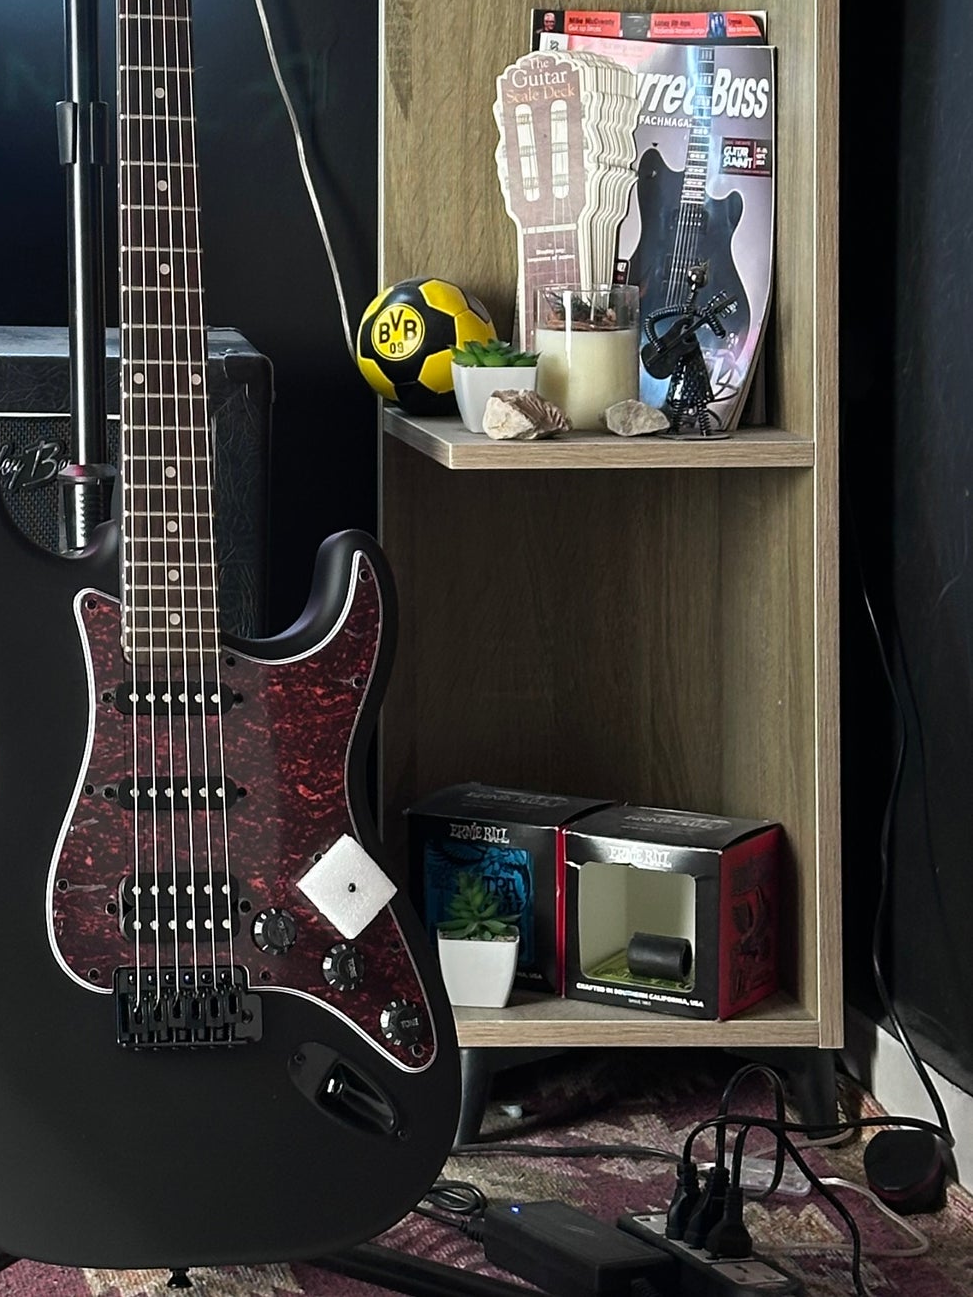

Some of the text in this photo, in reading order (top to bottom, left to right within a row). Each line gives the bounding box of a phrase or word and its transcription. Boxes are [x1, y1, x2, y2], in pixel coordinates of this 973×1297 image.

[528, 57, 550, 70] The
[512, 69, 568, 89] Guitar
[506, 83, 576, 104] Scale Deck
[711, 68, 770, 119] Bass
[379, 310, 417, 343] BVB
[389, 341, 405, 354] 09
[449, 821, 510, 844] ERNIE BALL
[645, 850, 672, 869] BALL
[482, 875, 519, 897] TRA
[575, 982, 606, 993] CRAFTED
[690, 999, 704, 1008] USA
[401, 1017, 420, 1029] TONE
